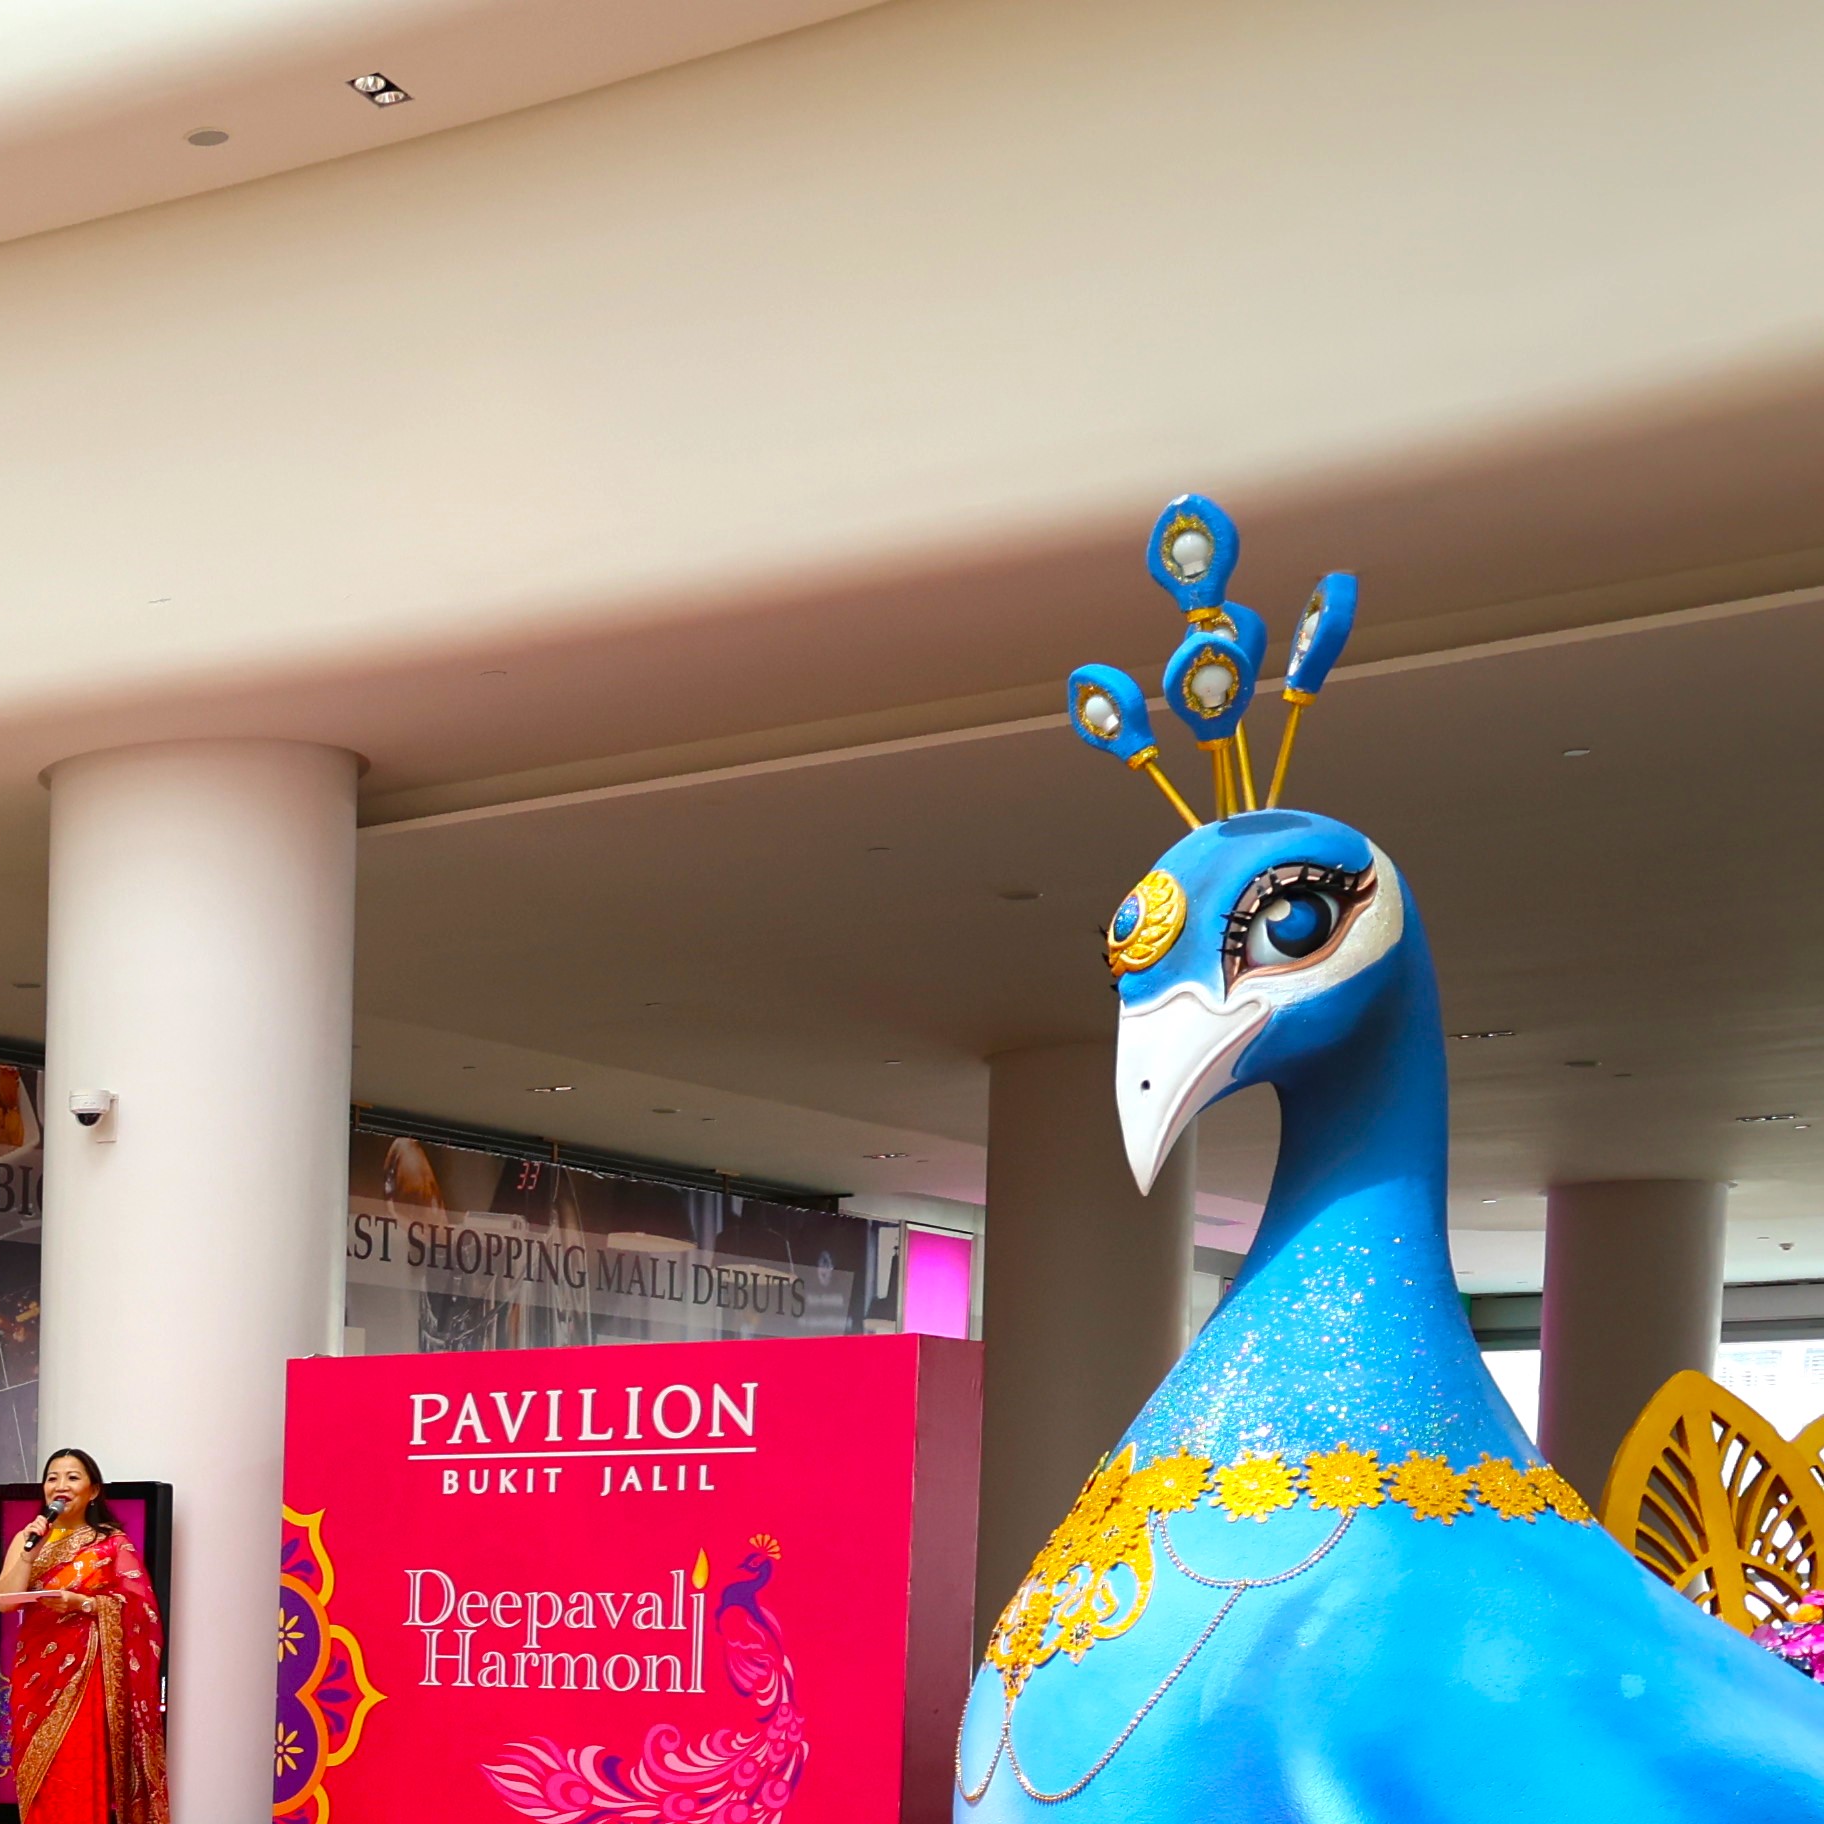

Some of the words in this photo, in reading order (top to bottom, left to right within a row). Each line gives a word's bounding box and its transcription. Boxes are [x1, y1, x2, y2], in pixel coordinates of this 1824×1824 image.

[346, 1213, 398, 1263] ST
[405, 1218, 588, 1290] SHOPPING
[596, 1252, 685, 1302] MALL
[692, 1263, 807, 1319] DEBUTS
[407, 1382, 759, 1447] PAVILION
[443, 1466, 564, 1496] BUKIT
[600, 1463, 717, 1497] JALIL
